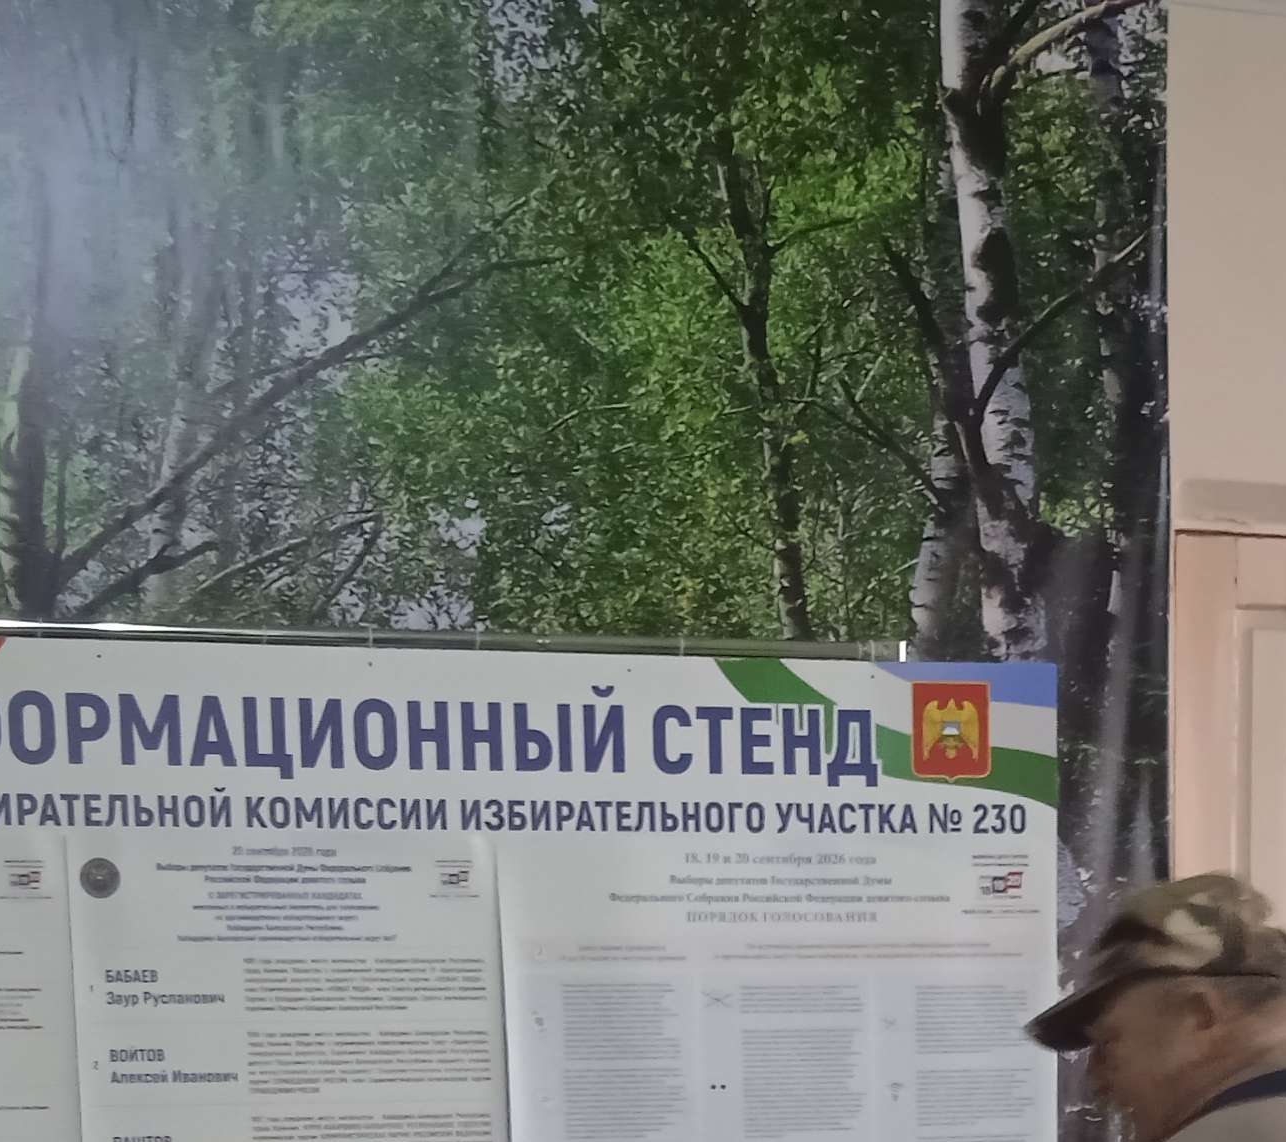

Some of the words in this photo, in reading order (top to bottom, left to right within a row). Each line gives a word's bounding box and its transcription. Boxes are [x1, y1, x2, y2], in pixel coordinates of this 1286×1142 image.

[652, 703, 880, 788] СТЕНД
[247, 796, 448, 831] КОМИССИИ
[460, 799, 766, 834] ИЗБИРАТЕЛЬНОГО
[775, 801, 918, 835] УЧАСТКА
[927, 803, 963, 834] №
[972, 803, 1028, 836] 230
[684, 852, 702, 865] 18,
[705, 852, 721, 865] 19
[735, 852, 751, 865] 20
[752, 853, 813, 868] сентября
[816, 853, 847, 865] 2026
[686, 911, 759, 924] ПОРЯДОК
[762, 911, 878, 924] ГОЛОСОВАНИЯ
[105, 968, 159, 984] БАБАЕВ
[106, 990, 139, 1008] Заур
[142, 990, 226, 1008] Русланович
[109, 1045, 166, 1063] ВОЙТОВ
[110, 1069, 169, 1084] Алексей
